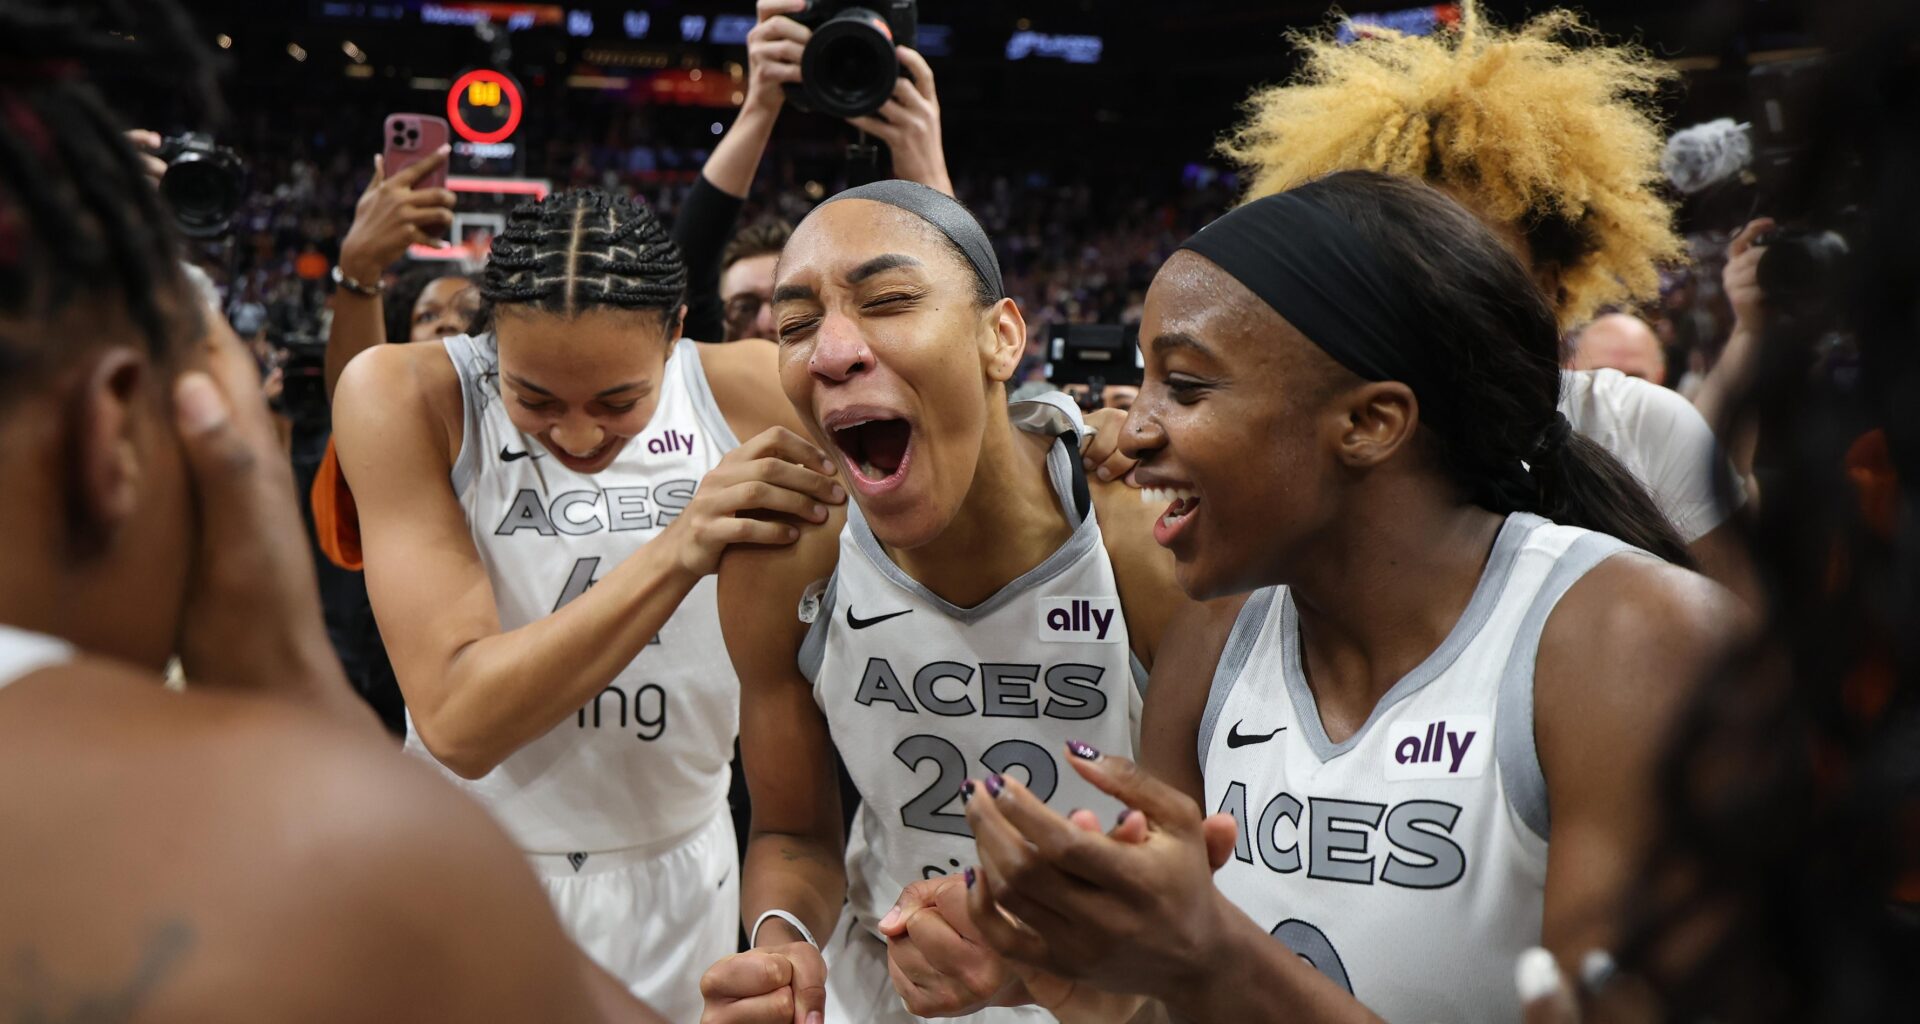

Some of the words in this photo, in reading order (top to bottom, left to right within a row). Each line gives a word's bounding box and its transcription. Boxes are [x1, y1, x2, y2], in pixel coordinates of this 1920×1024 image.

[647, 429, 694, 456] ally
[494, 479, 698, 536] ACES
[1046, 599, 1115, 640] ally
[854, 656, 1108, 721] ACES
[1394, 720, 1477, 774] ally
[1216, 780, 1467, 890] ACES
